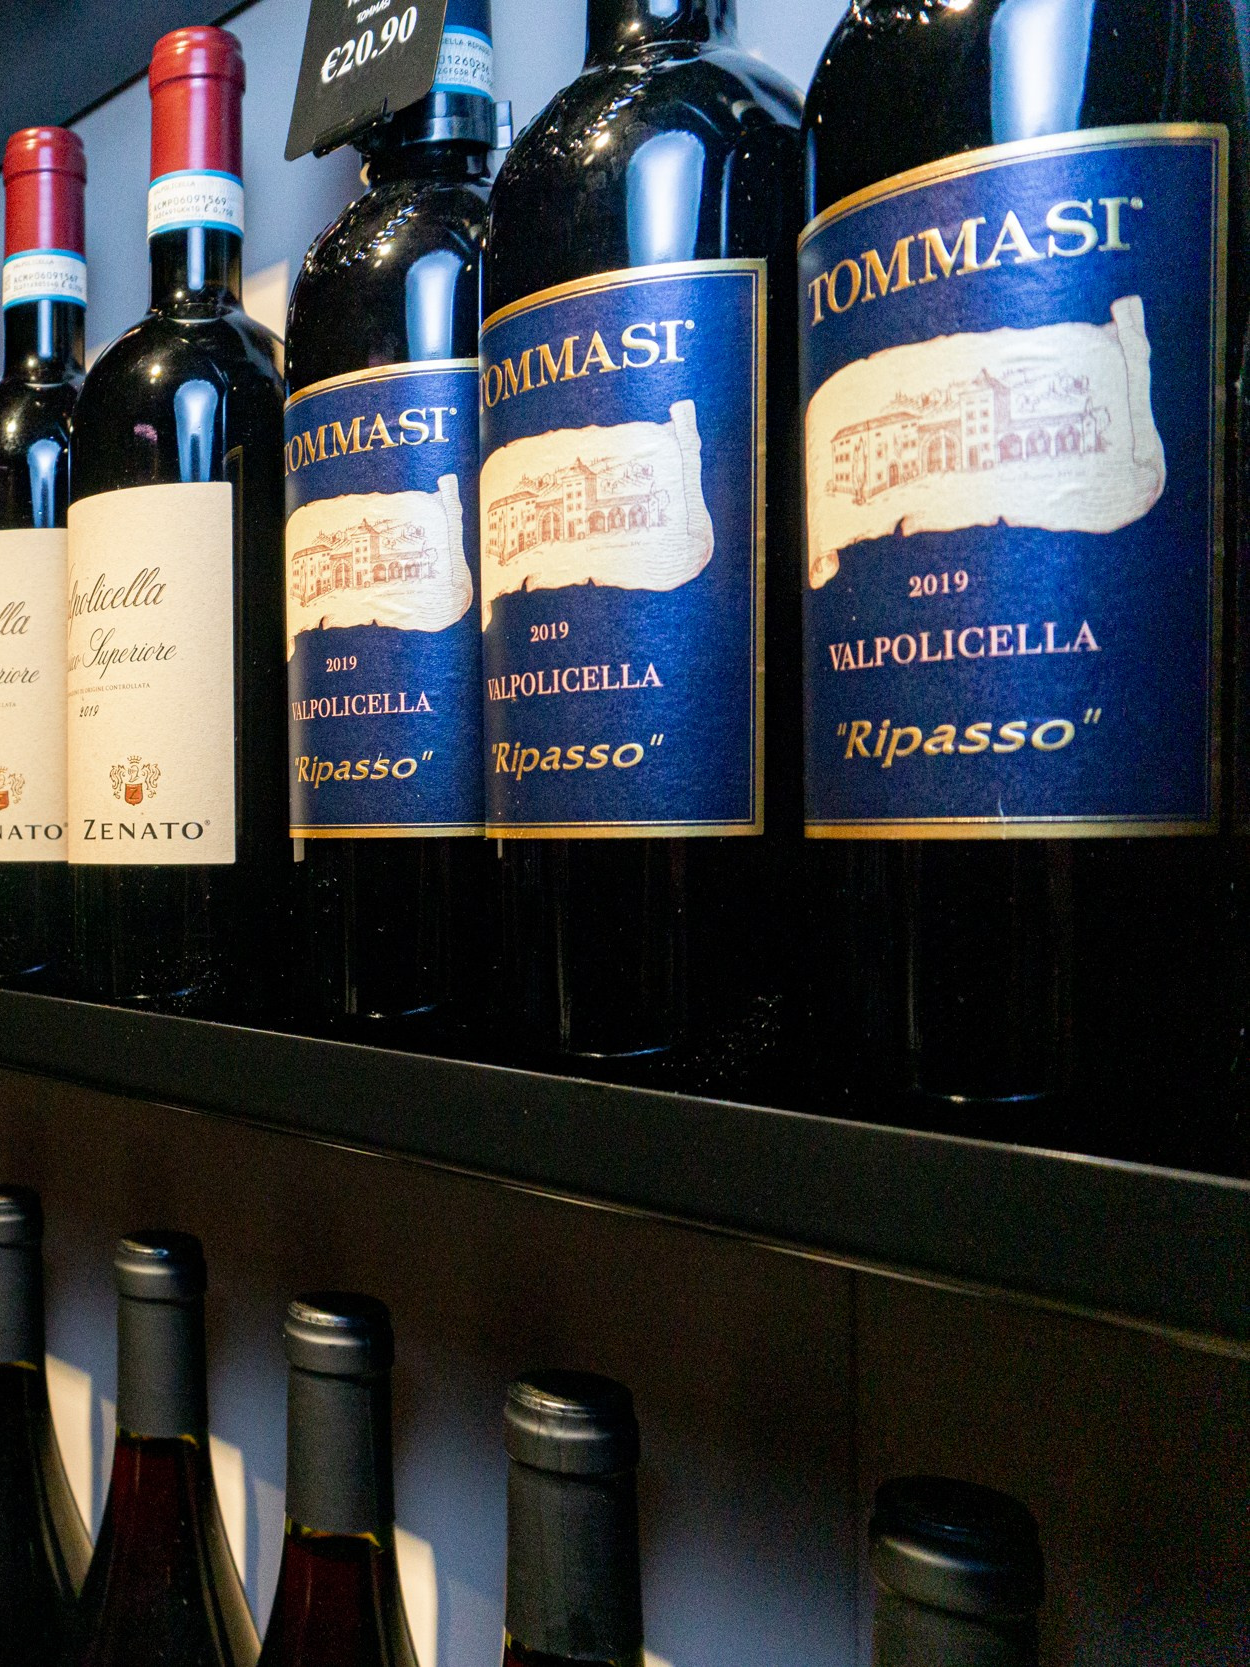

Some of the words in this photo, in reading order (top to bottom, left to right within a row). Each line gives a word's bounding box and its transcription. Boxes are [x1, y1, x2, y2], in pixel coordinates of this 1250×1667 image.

[321, 6, 417, 83] €20.90
[908, 569, 969, 598] 2019
[530, 621, 570, 642] 2019
[828, 619, 1102, 671] VALPOLICELLA
[83, 627, 177, 679] Superiore
[325, 655, 358, 673] 2019
[105, 682, 150, 692] CONTROLLATA
[487, 661, 663, 701] VALPOLICELLA
[79, 704, 99, 718] 2019
[291, 690, 434, 721] VALPOLICELLA
